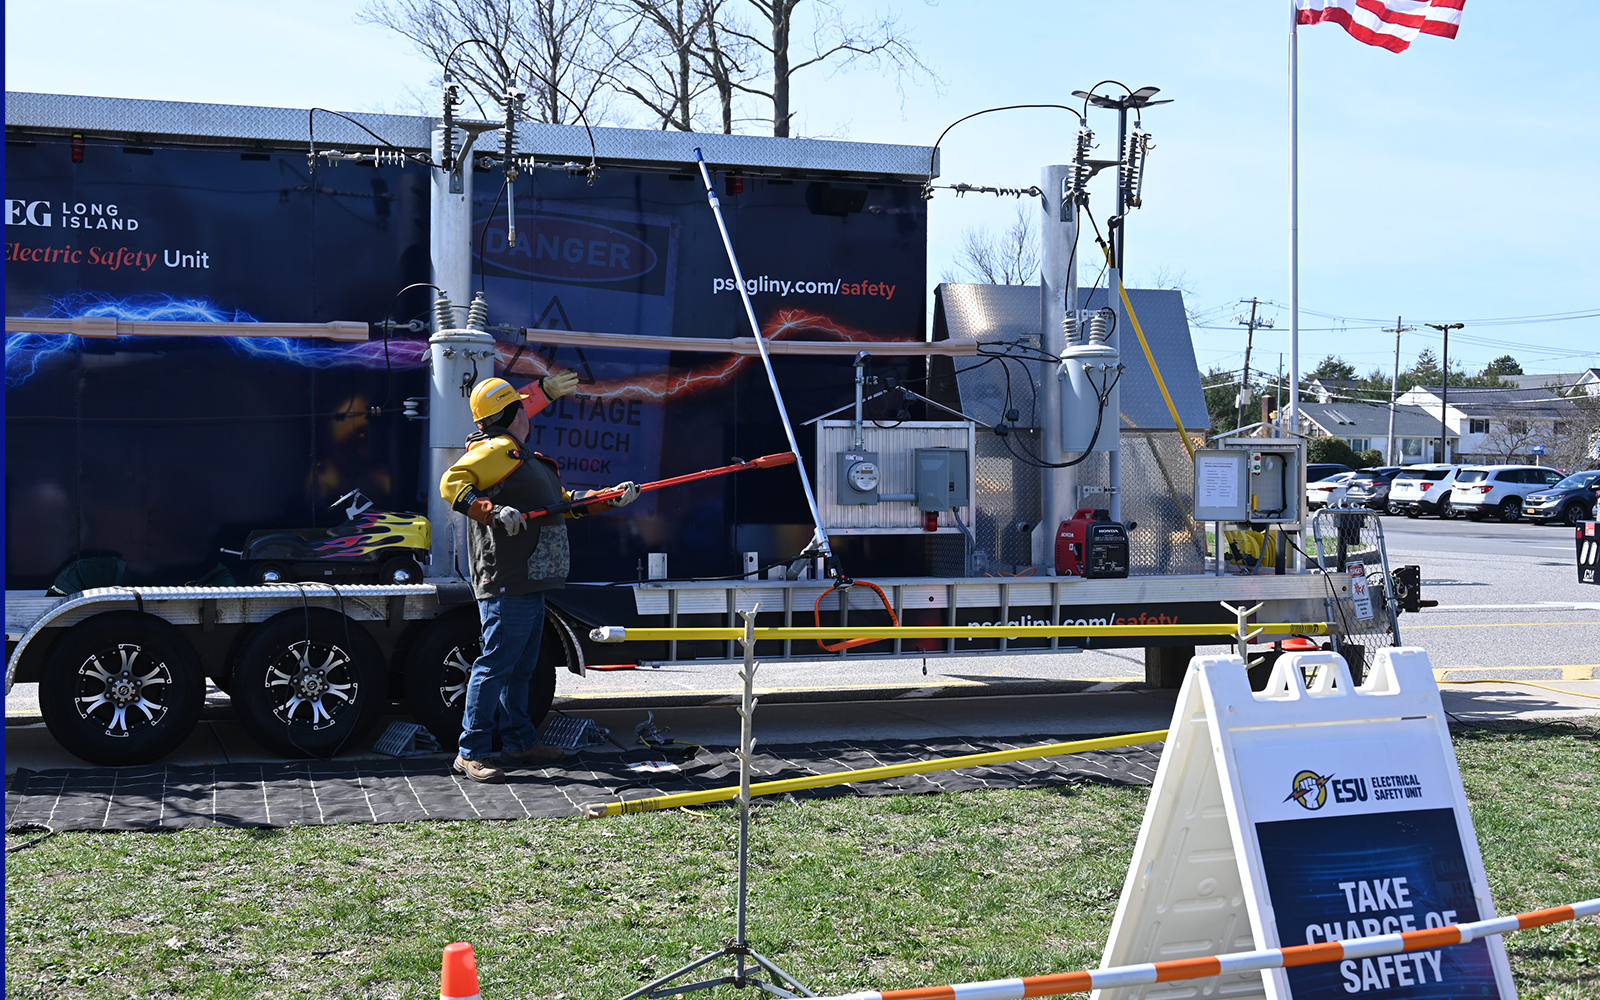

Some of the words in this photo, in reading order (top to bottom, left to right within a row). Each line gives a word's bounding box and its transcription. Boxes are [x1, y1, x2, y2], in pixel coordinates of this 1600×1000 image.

[62, 202, 118, 216] LONG
[62, 216, 139, 231] ISLAND
[5, 243, 82, 264] Electric
[88, 246, 157, 271] Safety
[164, 249, 209, 269] Unit
[486, 227, 630, 269] DANGER
[541, 395, 643, 426] OLTAGE
[554, 426, 630, 453] TOUCH
[557, 456, 611, 475] SHOCK
[1331, 778, 1368, 804] ESU
[1371, 774, 1420, 788] ELECTRICAL
[1374, 788, 1404, 801] SAFETY
[1404, 786, 1423, 799] UNIT
[1338, 877, 1413, 914] TAKE
[1340, 950, 1443, 994] SAFETY
